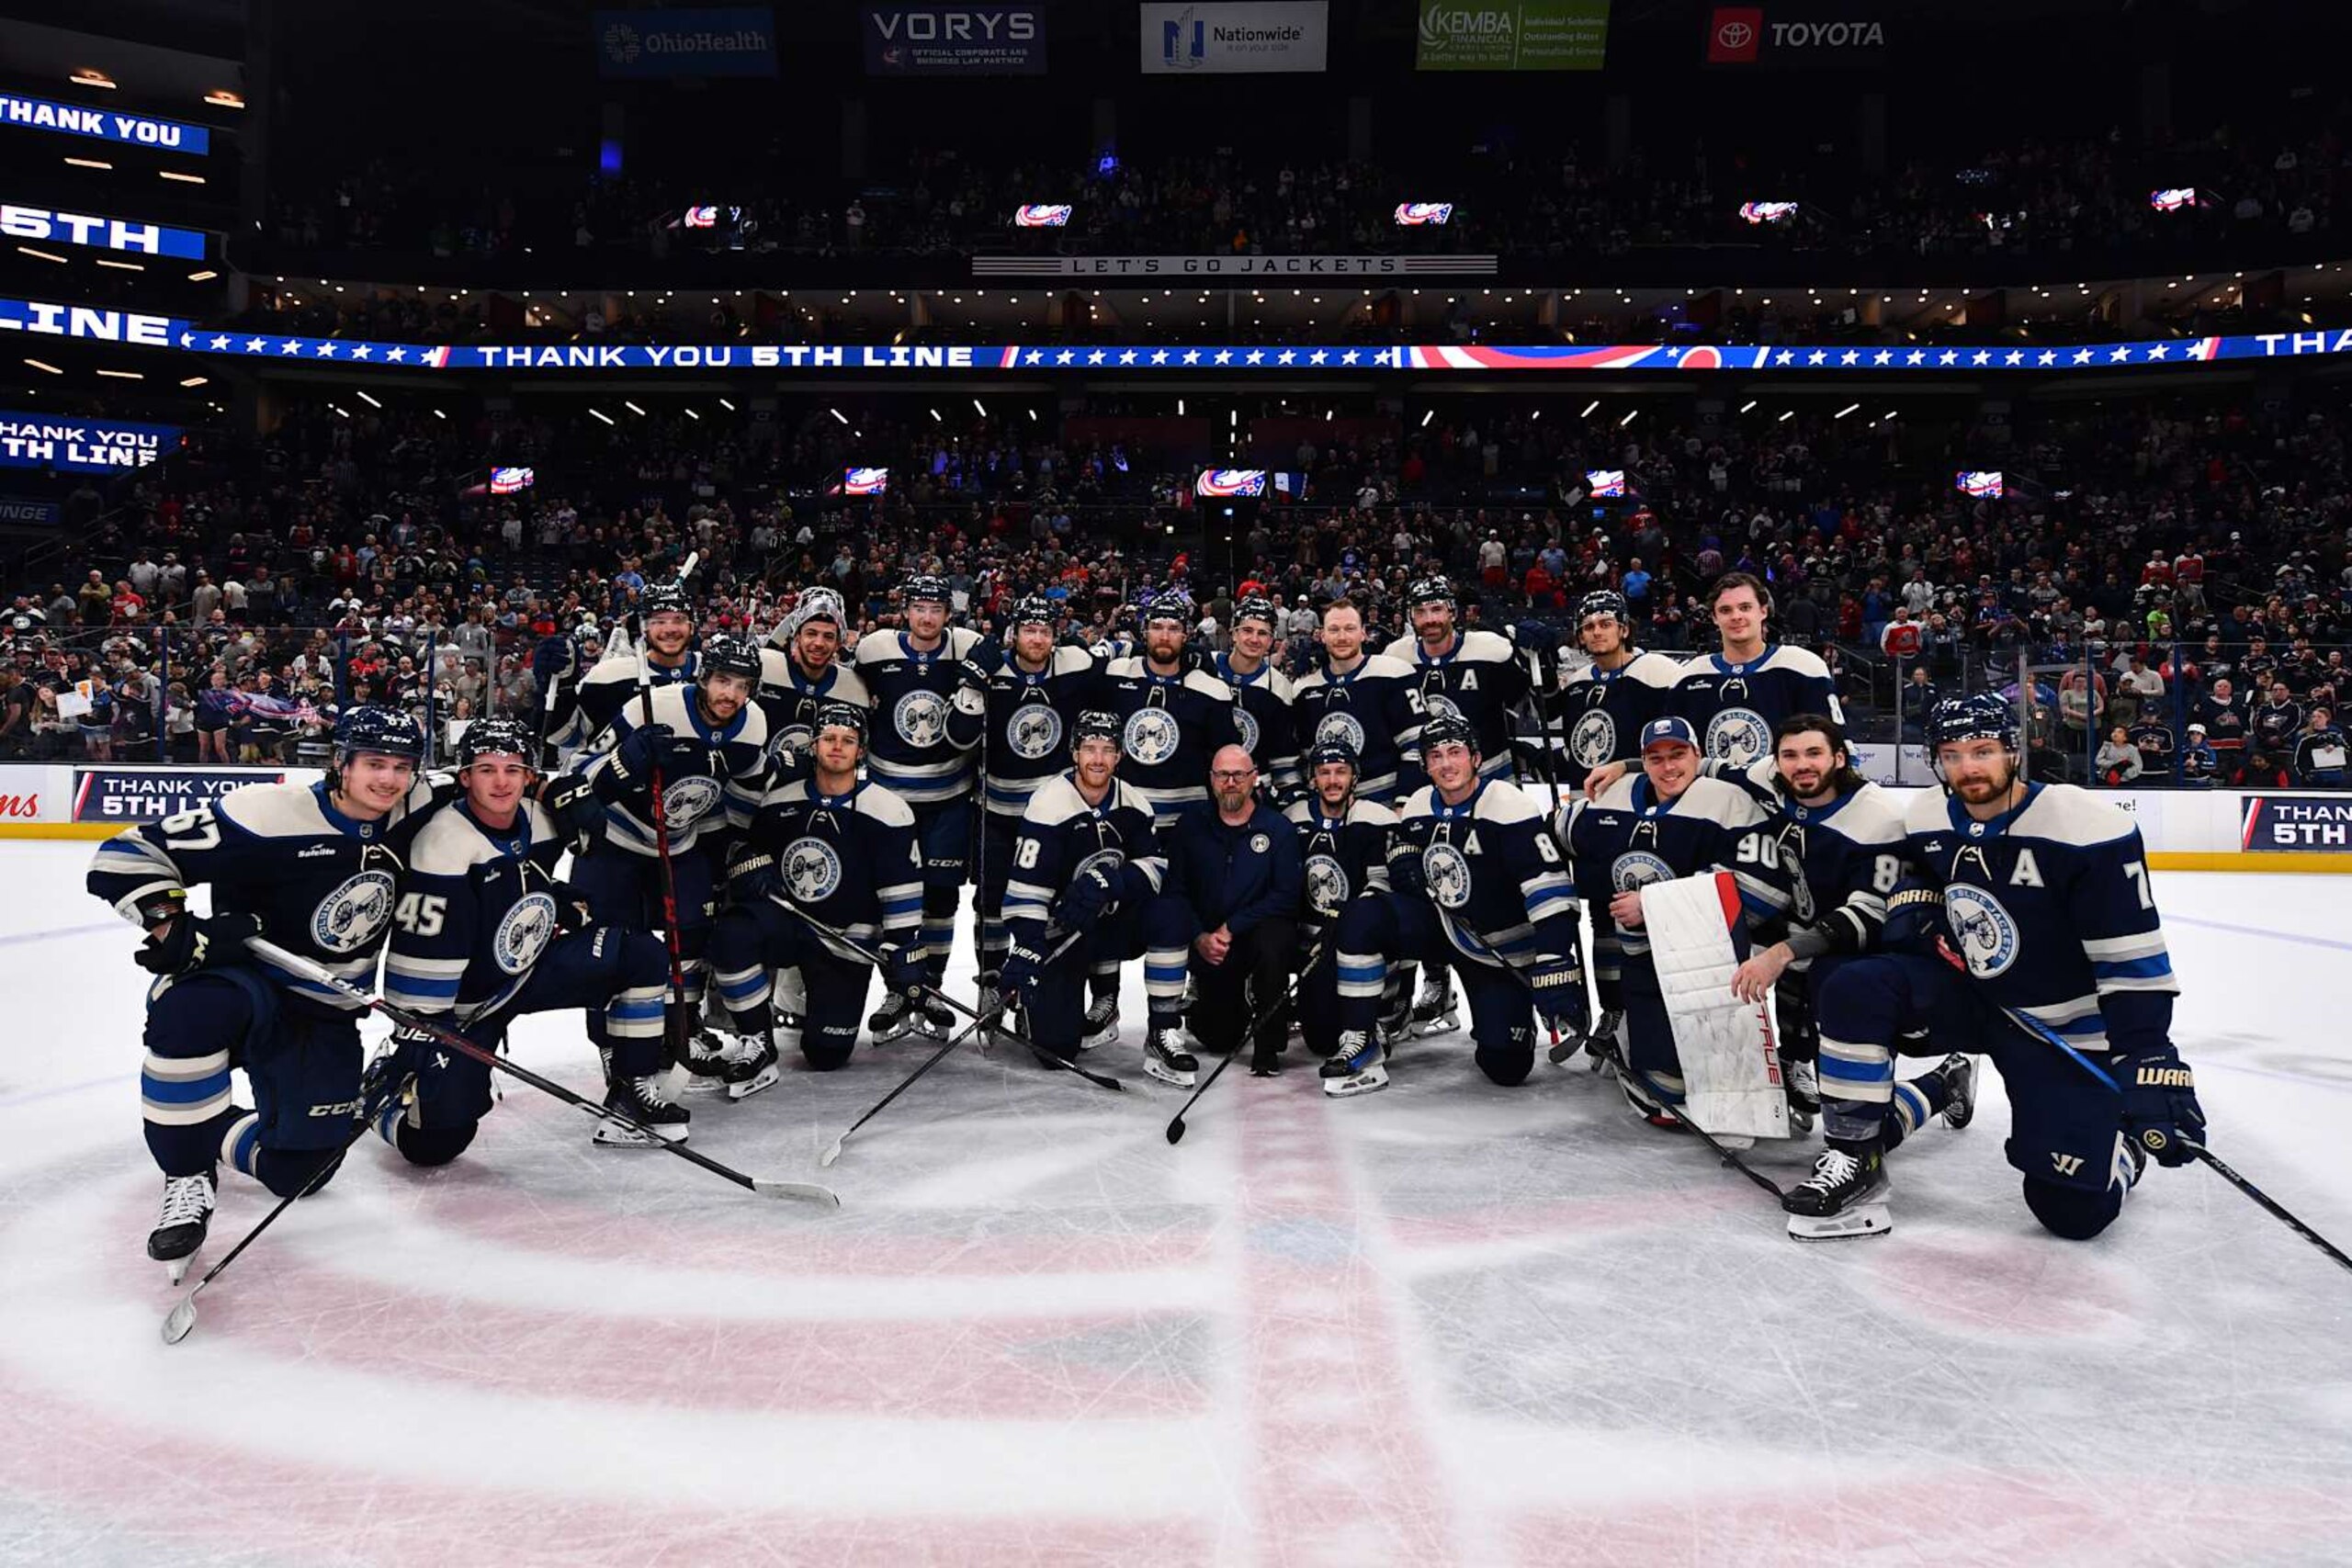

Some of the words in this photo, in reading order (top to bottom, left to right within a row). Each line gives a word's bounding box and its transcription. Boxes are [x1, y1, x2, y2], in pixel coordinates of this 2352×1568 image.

[873, 13, 1035, 39] VORYS
[1436, 12, 1512, 33] KEMBA
[646, 31, 766, 53] OhioHealth
[1214, 27, 1301, 41] Nationwide
[1451, 35, 1512, 44] FINANCIAL
[1771, 22, 1884, 46] TOYOTA
[115, 117, 181, 147] YOU
[0, 204, 160, 255] 5TH
[1073, 259, 1159, 273] LET'S
[1183, 259, 1221, 273] GO
[1240, 258, 1395, 273] JACKETS
[477, 346, 626, 367] THANK
[645, 346, 731, 367] YOU
[752, 346, 842, 367] 5TH
[864, 346, 972, 367] LINE
[96, 430, 157, 448] YOU
[0, 505, 49, 521] NGE
[1459, 669, 1479, 691] A
[103, 779, 192, 794] THANK
[203, 780, 255, 794] YO
[102, 795, 166, 816] 5TH
[178, 795, 219, 814] LI
[1463, 829, 1484, 854] A
[2273, 823, 2346, 844] 5TH
[1736, 831, 1779, 869] 90
[928, 858, 964, 868] CCM
[2008, 848, 2045, 887] A
[394, 891, 447, 937] 45
[1958, 889, 1986, 905] BLUE
[1987, 905, 2012, 962] JACKETS
[1756, 1010, 1781, 1086] TRUE
